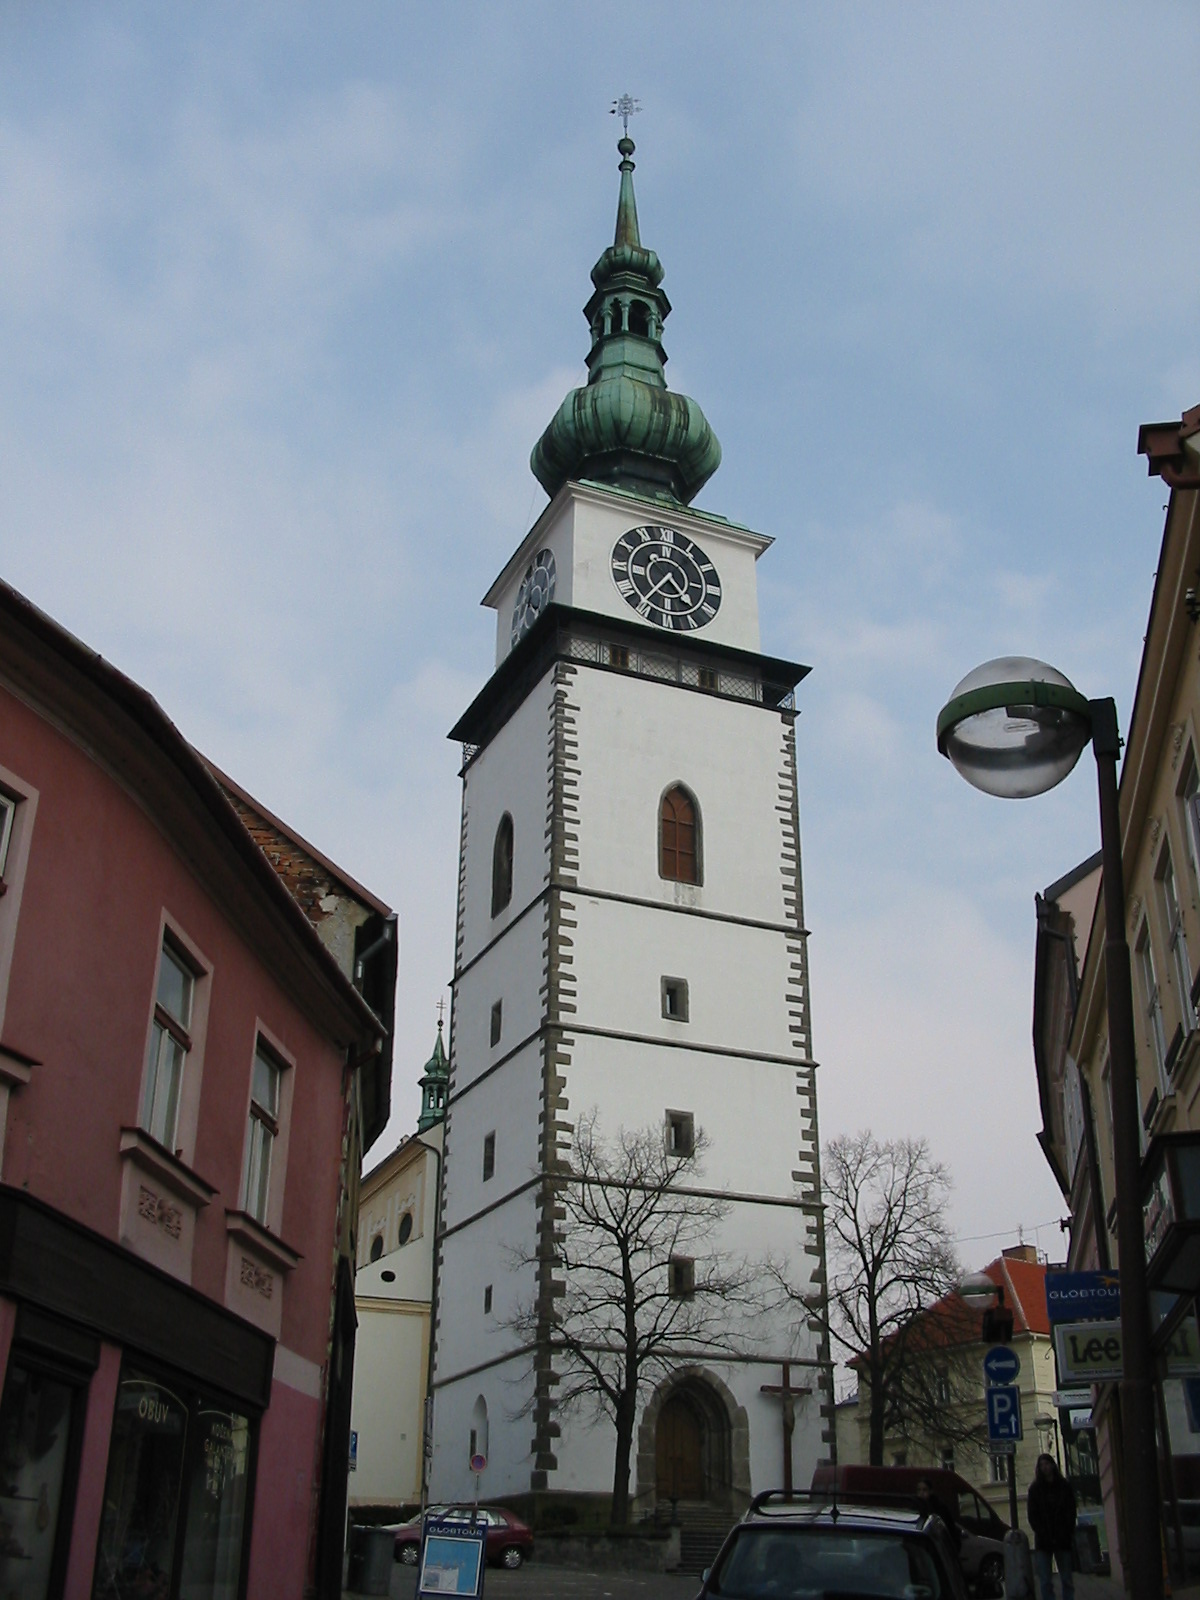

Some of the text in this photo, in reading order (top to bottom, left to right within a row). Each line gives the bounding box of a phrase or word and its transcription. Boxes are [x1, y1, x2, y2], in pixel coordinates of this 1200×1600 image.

[660, 527, 674, 543] XII
[662, 614, 673, 628] VI
[687, 614, 698, 628] V
[1069, 1335, 1121, 1363] Lee
[138, 1397, 169, 1422] OBUV
[993, 1393, 1011, 1425] P
